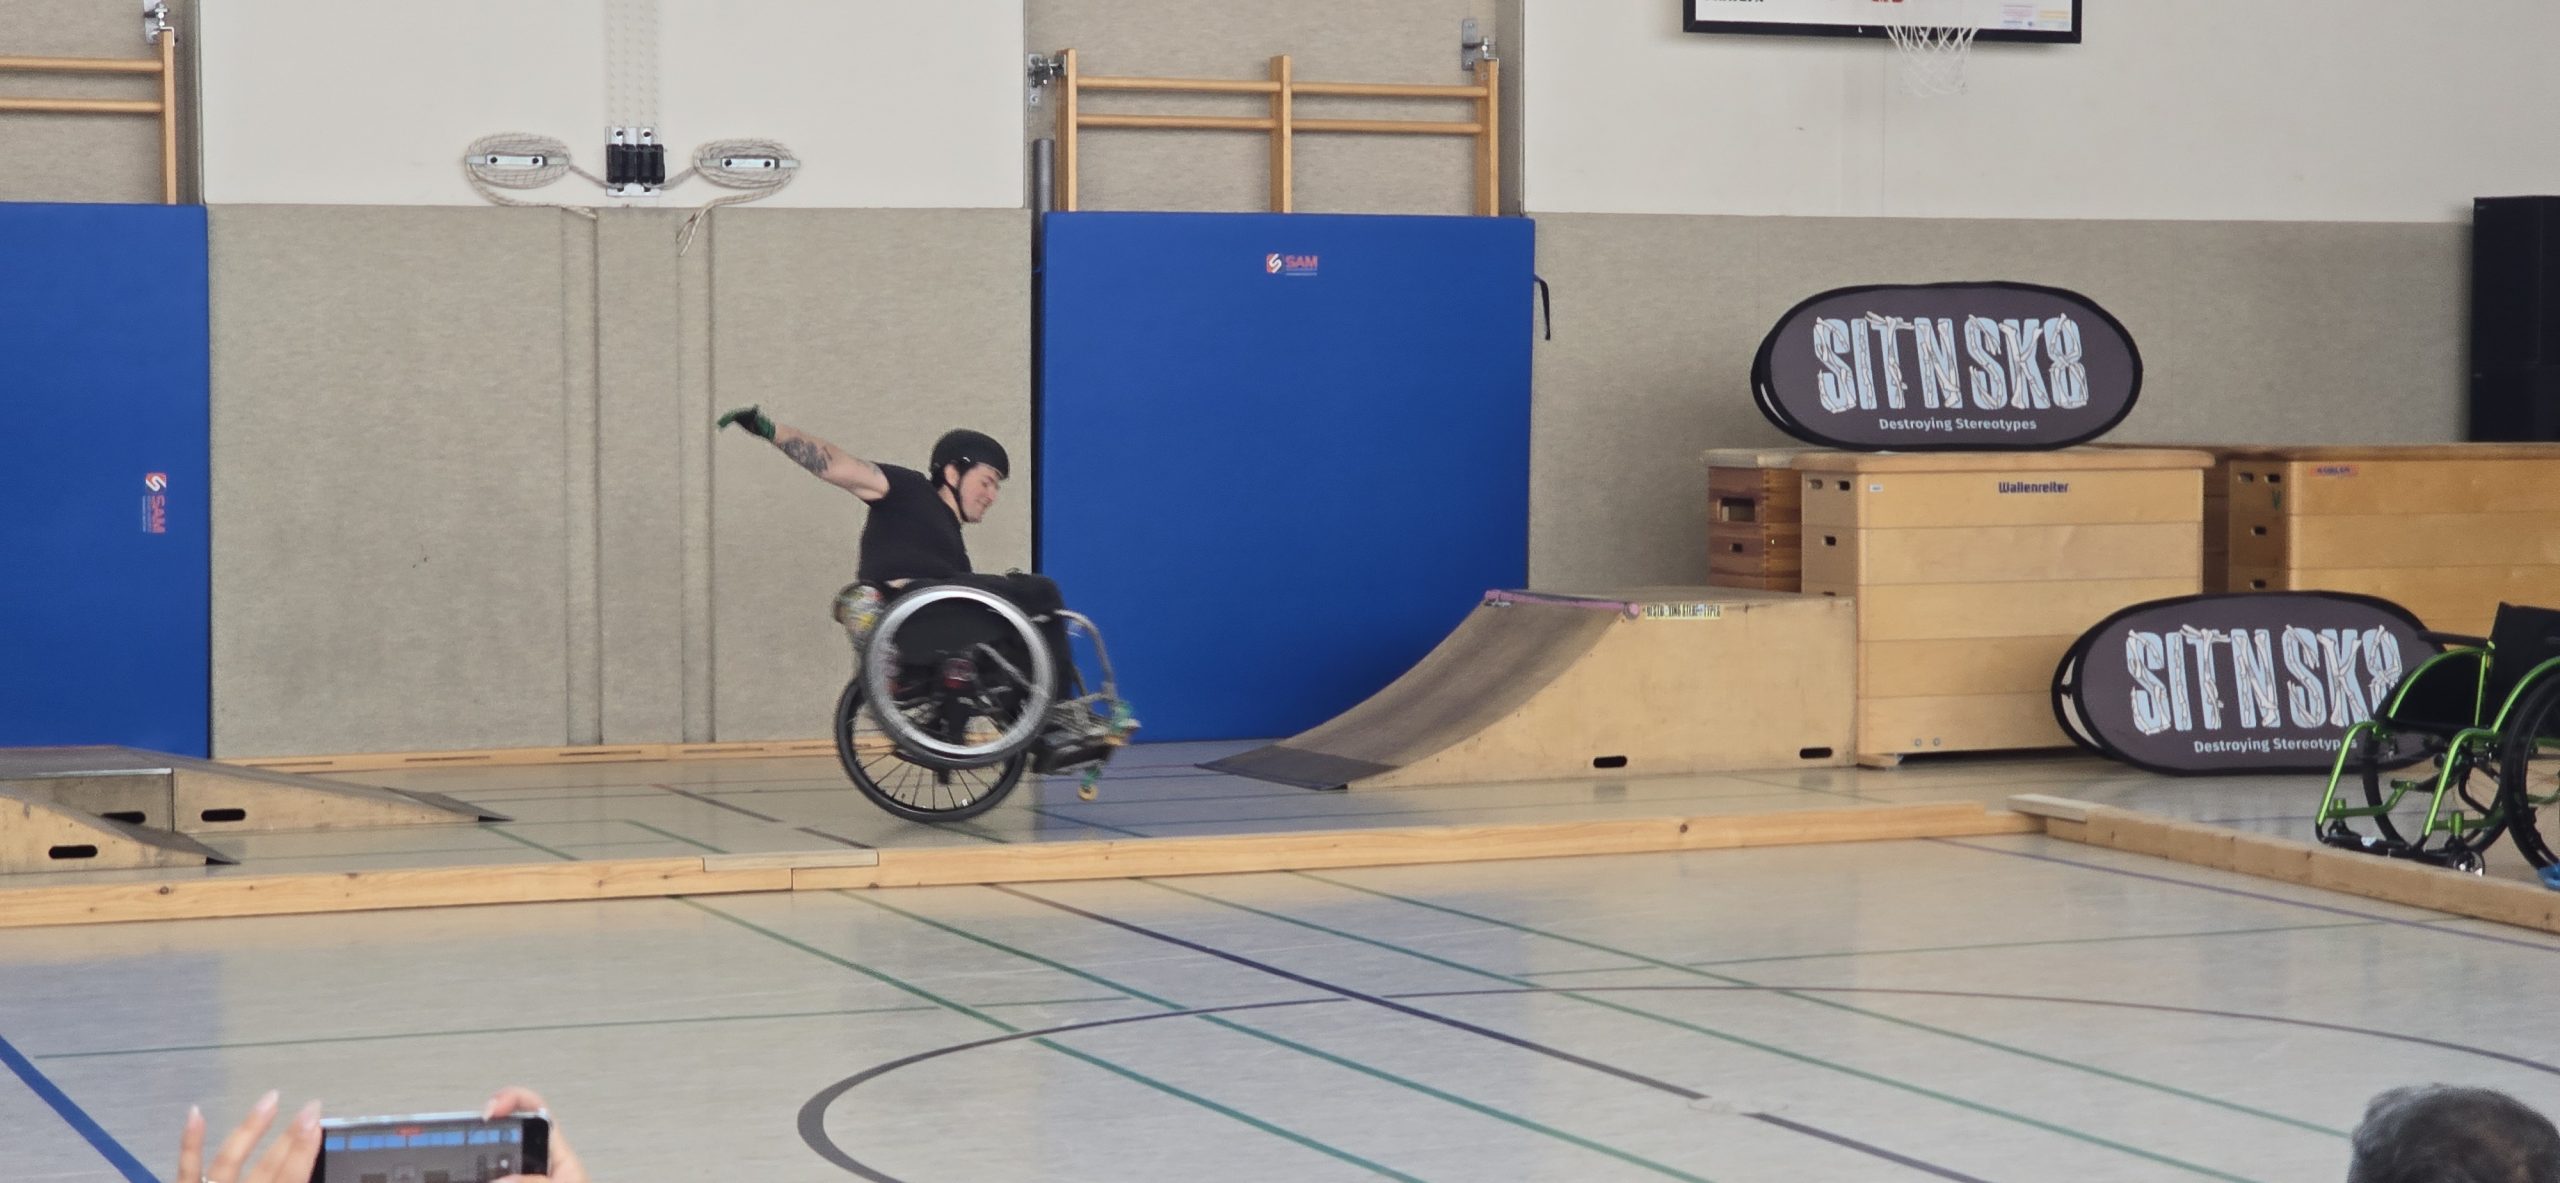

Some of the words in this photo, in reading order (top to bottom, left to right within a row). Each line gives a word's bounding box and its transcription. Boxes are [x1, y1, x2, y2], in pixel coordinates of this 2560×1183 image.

[1286, 255, 1318, 268] SAM
[1964, 313, 2089, 410] SK8
[1879, 416, 1952, 432] Destroying
[1955, 417, 2037, 432] Stereotypes
[1998, 481, 2069, 493] Wallenreiter
[152, 495, 165, 533] SAM
[2194, 738, 2270, 753] Destroying
[2273, 737, 2357, 751] Stereotyps
